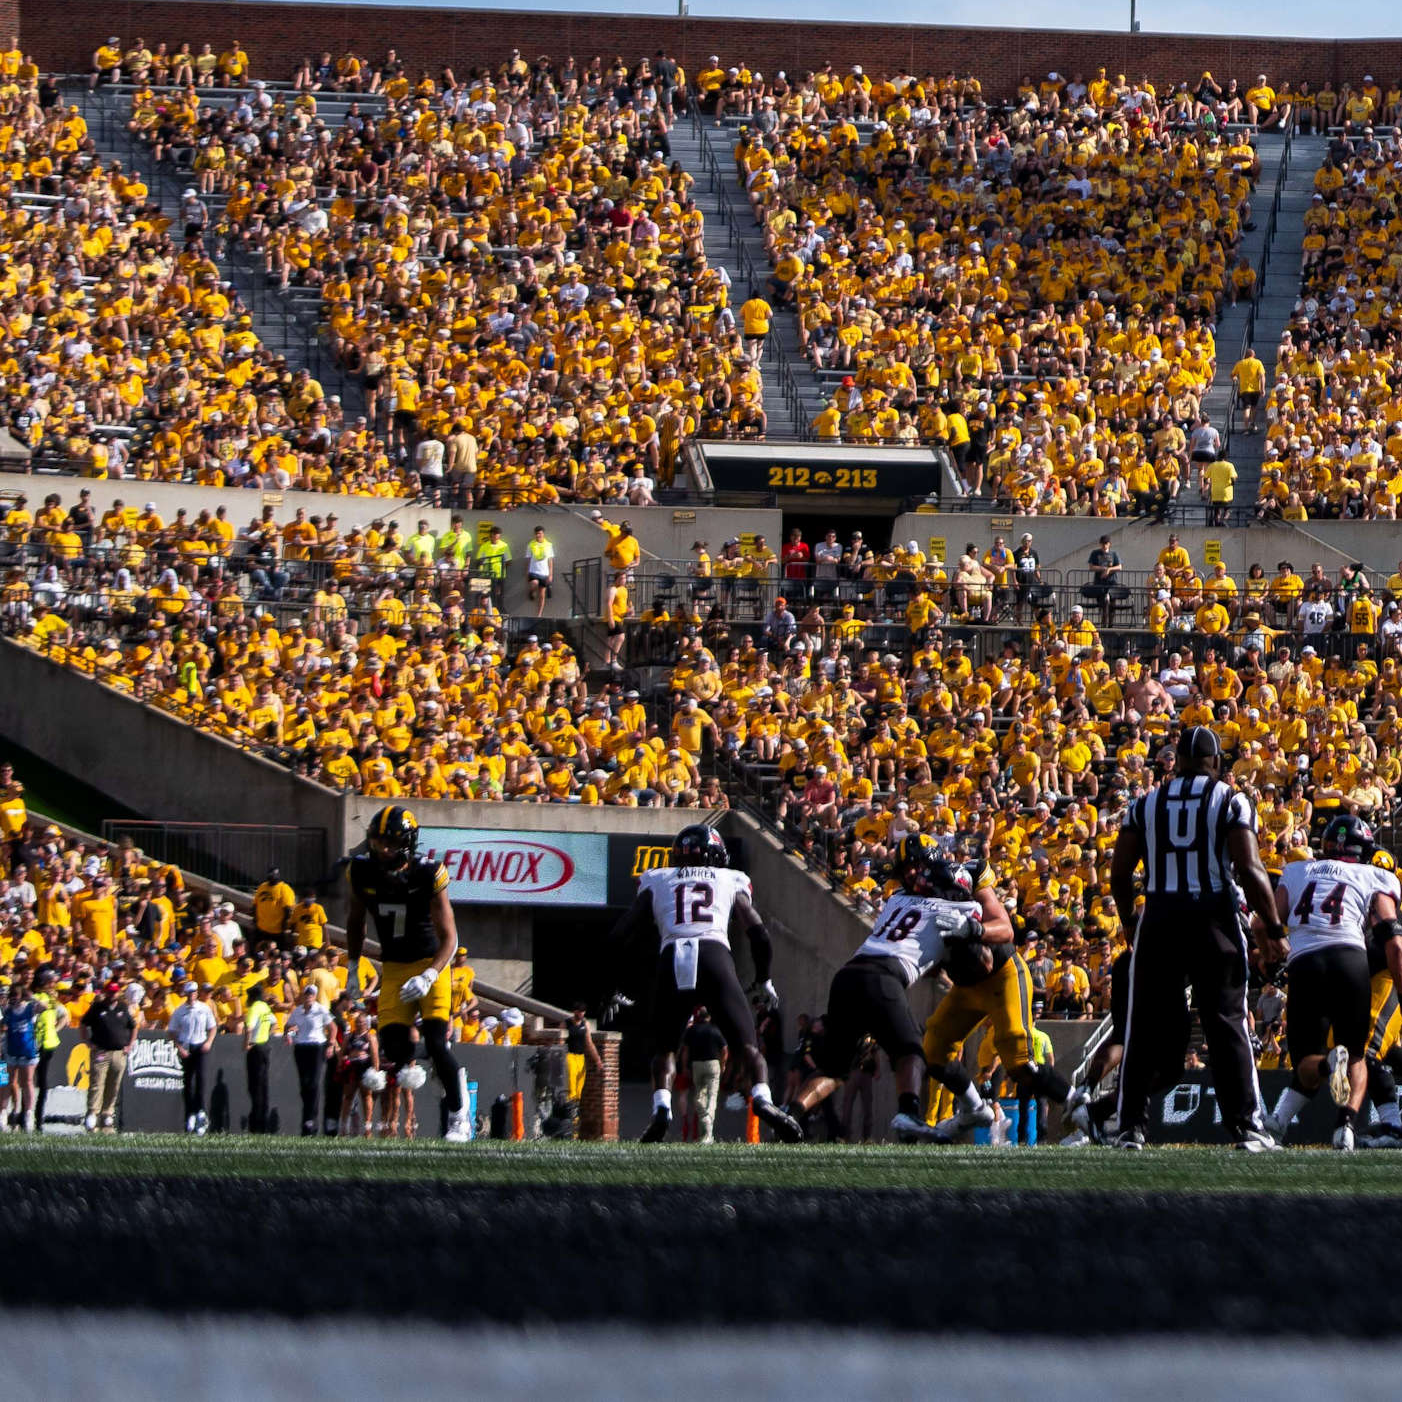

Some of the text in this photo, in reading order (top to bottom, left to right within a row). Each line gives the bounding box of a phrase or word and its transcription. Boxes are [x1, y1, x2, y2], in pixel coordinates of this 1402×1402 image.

[768, 466, 878, 488] 212 213
[1166, 797, 1200, 847] U
[377, 902, 407, 938] 7
[674, 882, 714, 925] 12
[1293, 881, 1347, 925] 44
[872, 905, 922, 943] 18
